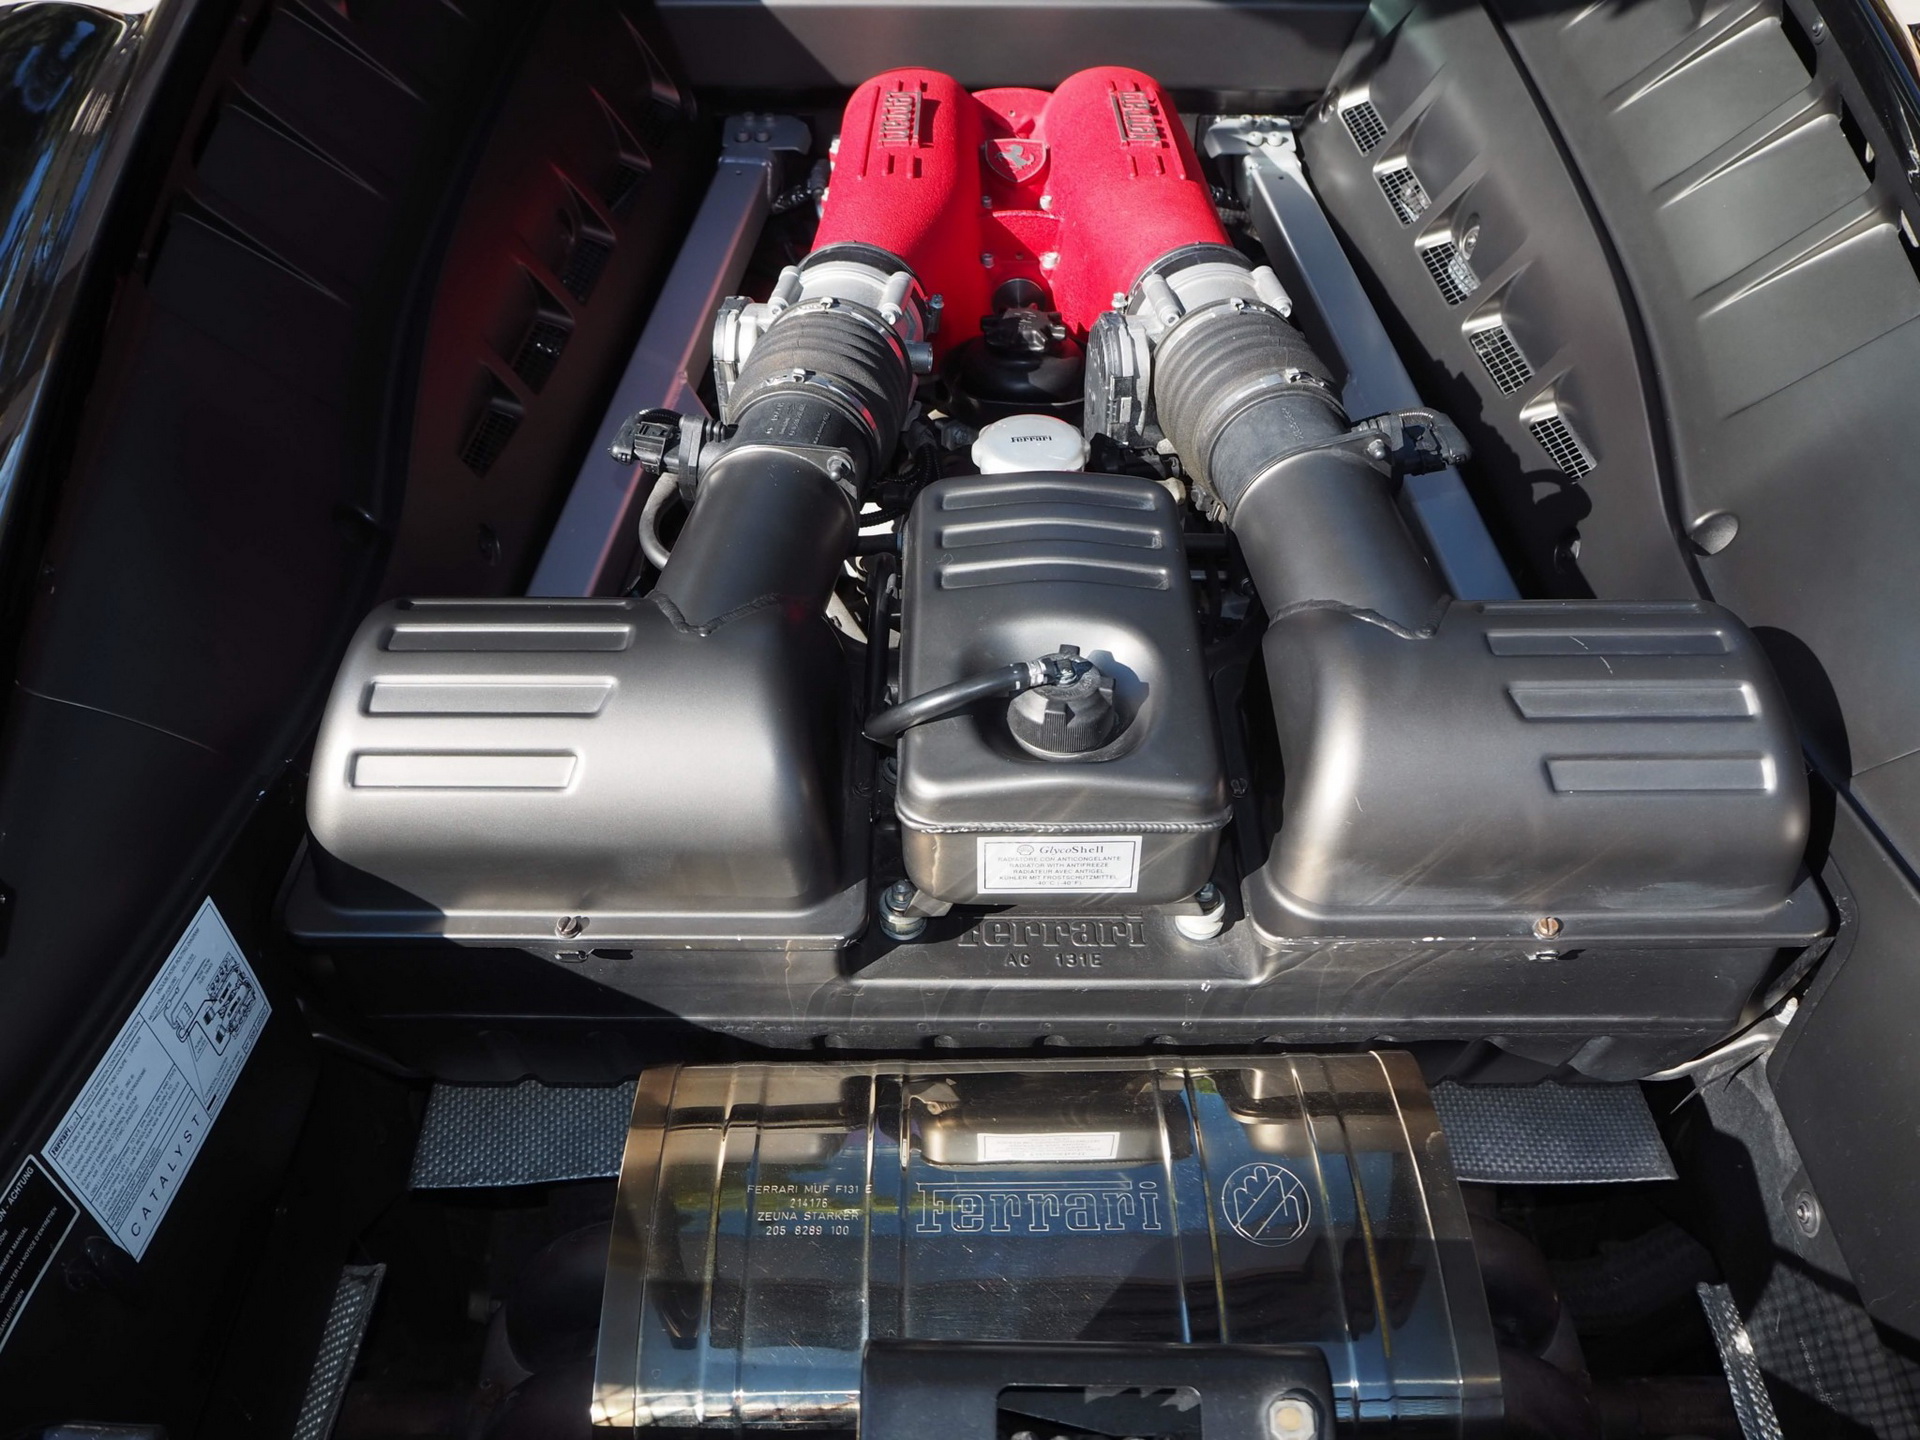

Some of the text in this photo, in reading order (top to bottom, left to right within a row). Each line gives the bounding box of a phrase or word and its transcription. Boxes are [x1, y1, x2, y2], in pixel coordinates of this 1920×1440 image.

[1040, 846, 1104, 854] GlycoShell
[1004, 952, 1102, 968] AC 131E
[129, 1111, 201, 1239] CATALYST
[7, 1166, 34, 1206] ACHTUNG
[748, 1185, 798, 1194] FERRARI
[836, 1185, 859, 1194] F131
[790, 1198, 828, 1208] 214176
[916, 1181, 1162, 1232] Ferrari
[758, 1212, 798, 1222] ZEUNA
[11, 1226, 29, 1250] MANUAL
[766, 1226, 850, 1236] 205 8289 100
[17, 1260, 24, 1270] LA
[22, 1240, 37, 1262] NOTICE
